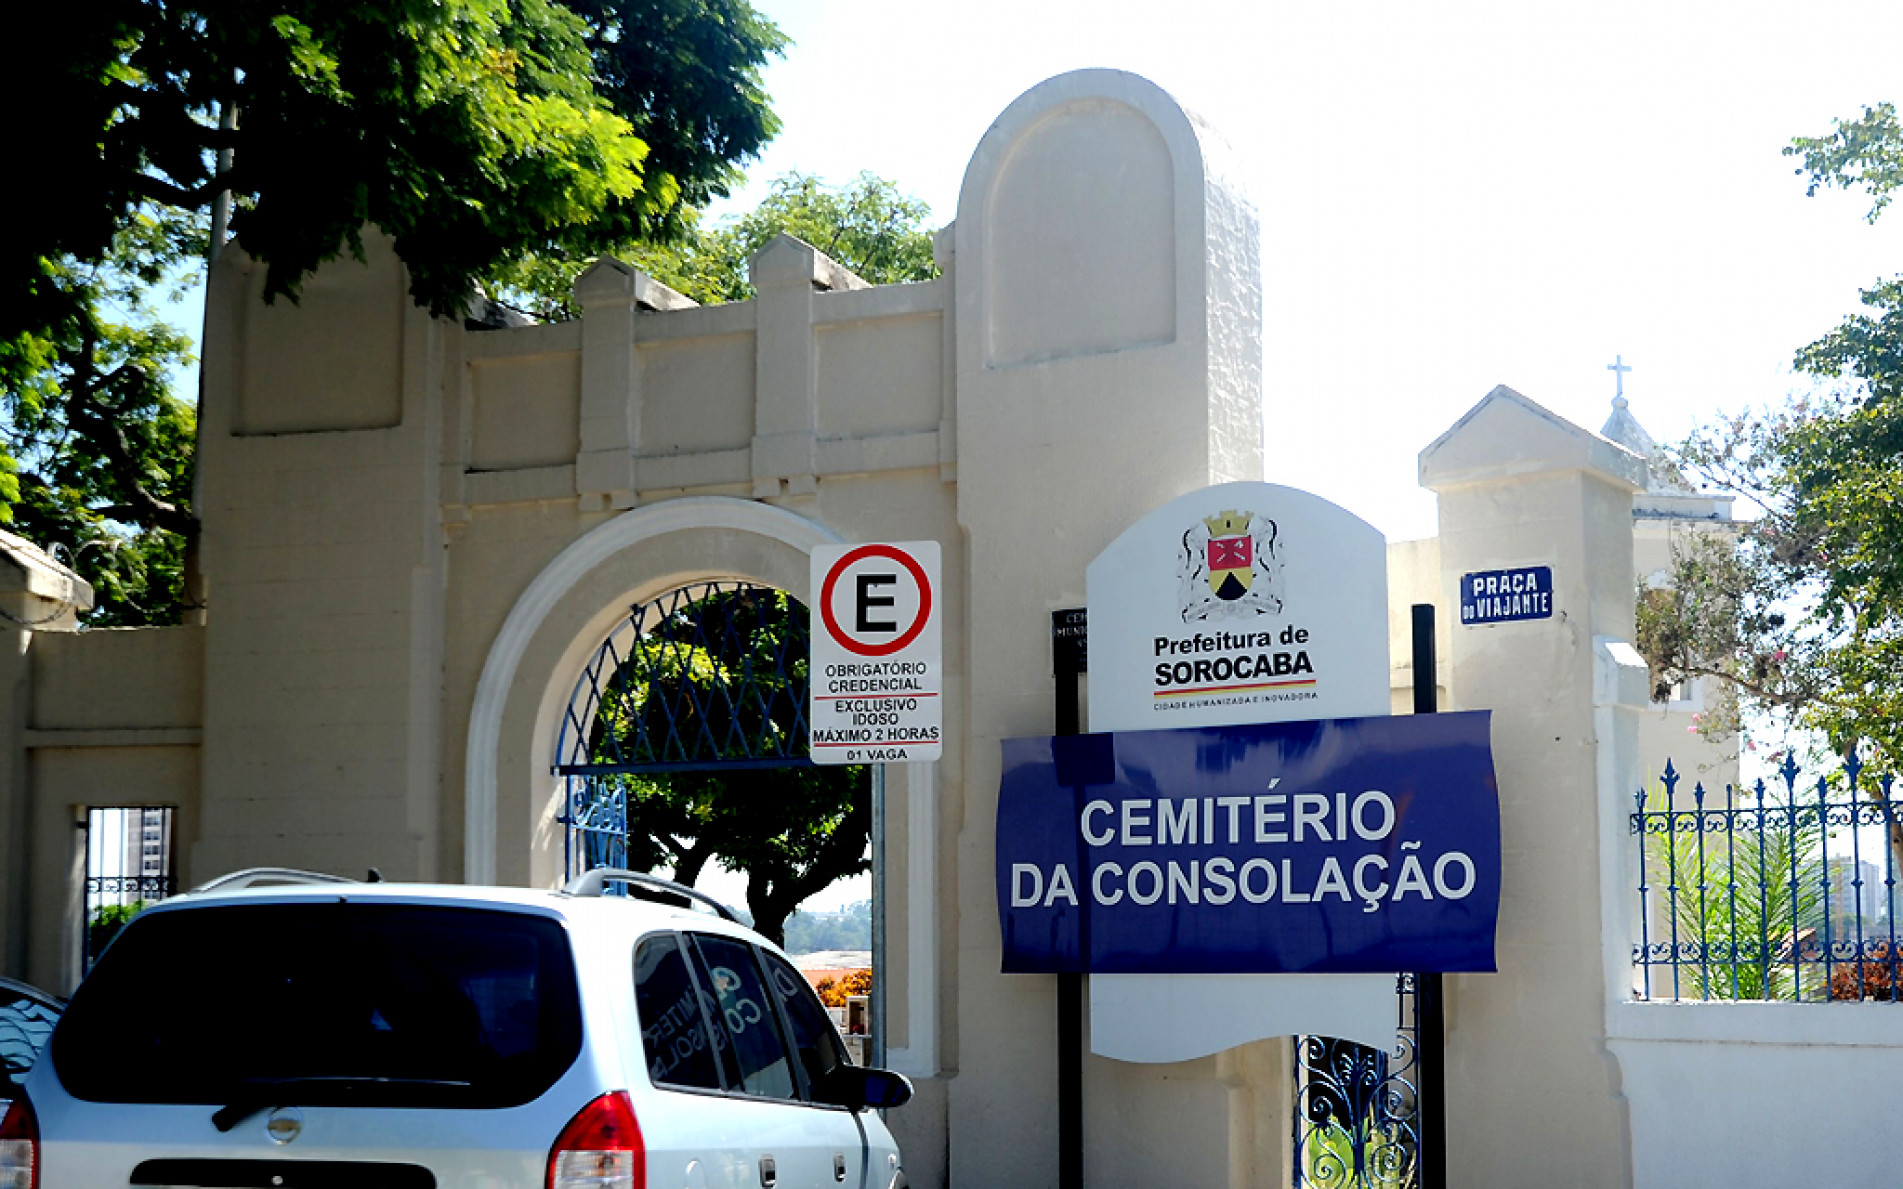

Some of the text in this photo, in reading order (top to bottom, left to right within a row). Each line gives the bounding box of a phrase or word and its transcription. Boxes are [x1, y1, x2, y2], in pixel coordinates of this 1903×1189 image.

[1473, 572, 1538, 596] PRAÇA
[856, 573, 897, 632] E
[1476, 592, 1549, 618] VIAJANTE
[1153, 625, 1310, 656] Prefeitura de
[825, 660, 927, 677] OBRIGATÓRIO
[1154, 651, 1314, 685] SOROCABA
[828, 678, 922, 693] CREDENCIAL
[835, 698, 917, 713] EXCLUSIVO
[1153, 702, 1187, 711] CIDADE
[1189, 697, 1251, 709] HUMANIZADA
[1262, 692, 1318, 703] INOVADORA
[852, 713, 899, 725] IDOSO
[813, 726, 940, 742] MÁXIMO 2 HORAS
[847, 749, 908, 760] 01 VAGA
[1080, 777, 1396, 846] CEMITÉRIO
[1010, 840, 1477, 912] DA CONSOLAÇÃO
